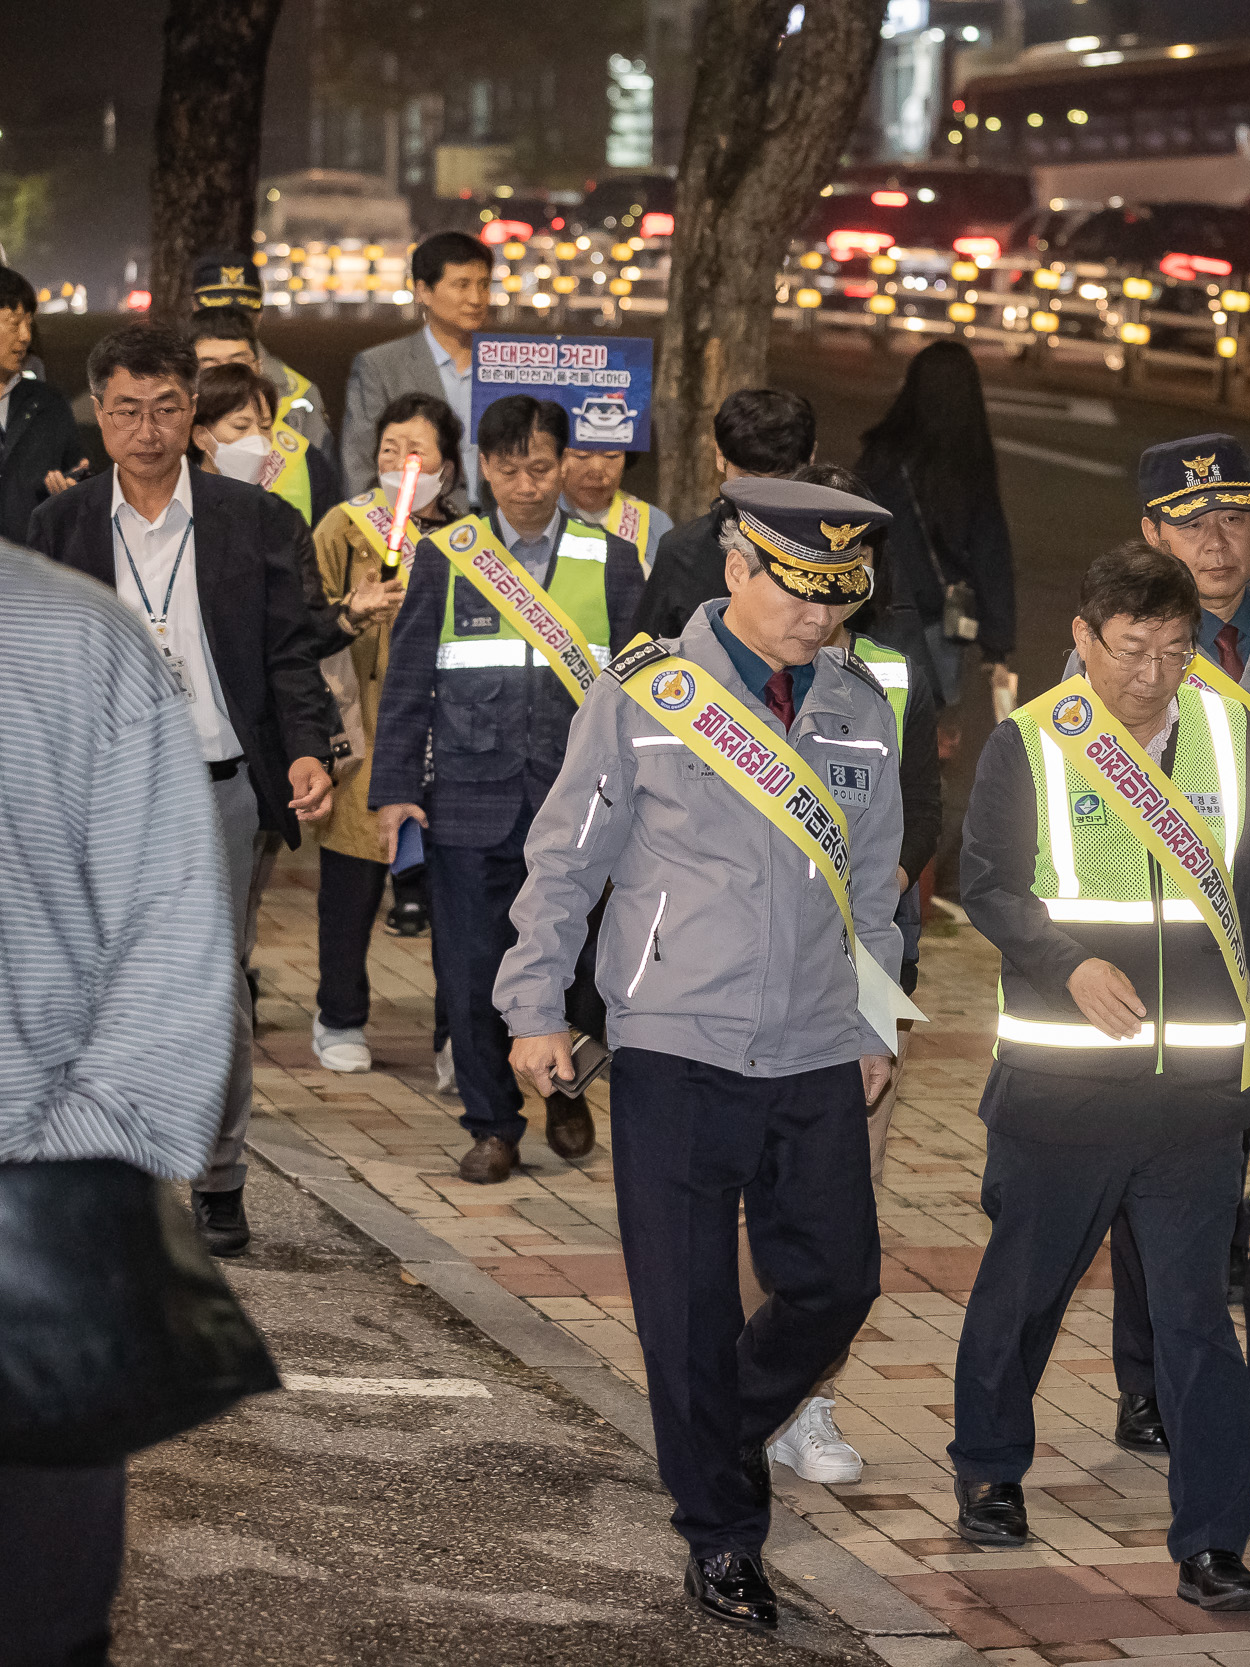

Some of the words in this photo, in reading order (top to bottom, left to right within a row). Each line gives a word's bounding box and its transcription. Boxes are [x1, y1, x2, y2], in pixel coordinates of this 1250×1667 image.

[481, 343, 556, 365] 건대맛의
[561, 346, 606, 367] 거리!
[472, 549, 534, 611] 안전하고
[522, 601, 572, 652] 건전한
[832, 765, 867, 789] 경찰
[693, 703, 795, 797] 범죄없는
[785, 784, 848, 880] 건대맛의
[833, 789, 867, 803] POLICE
[1086, 733, 1169, 821] 안전하고
[1151, 808, 1213, 878] 건전한
[1075, 815, 1103, 824] 광진구
